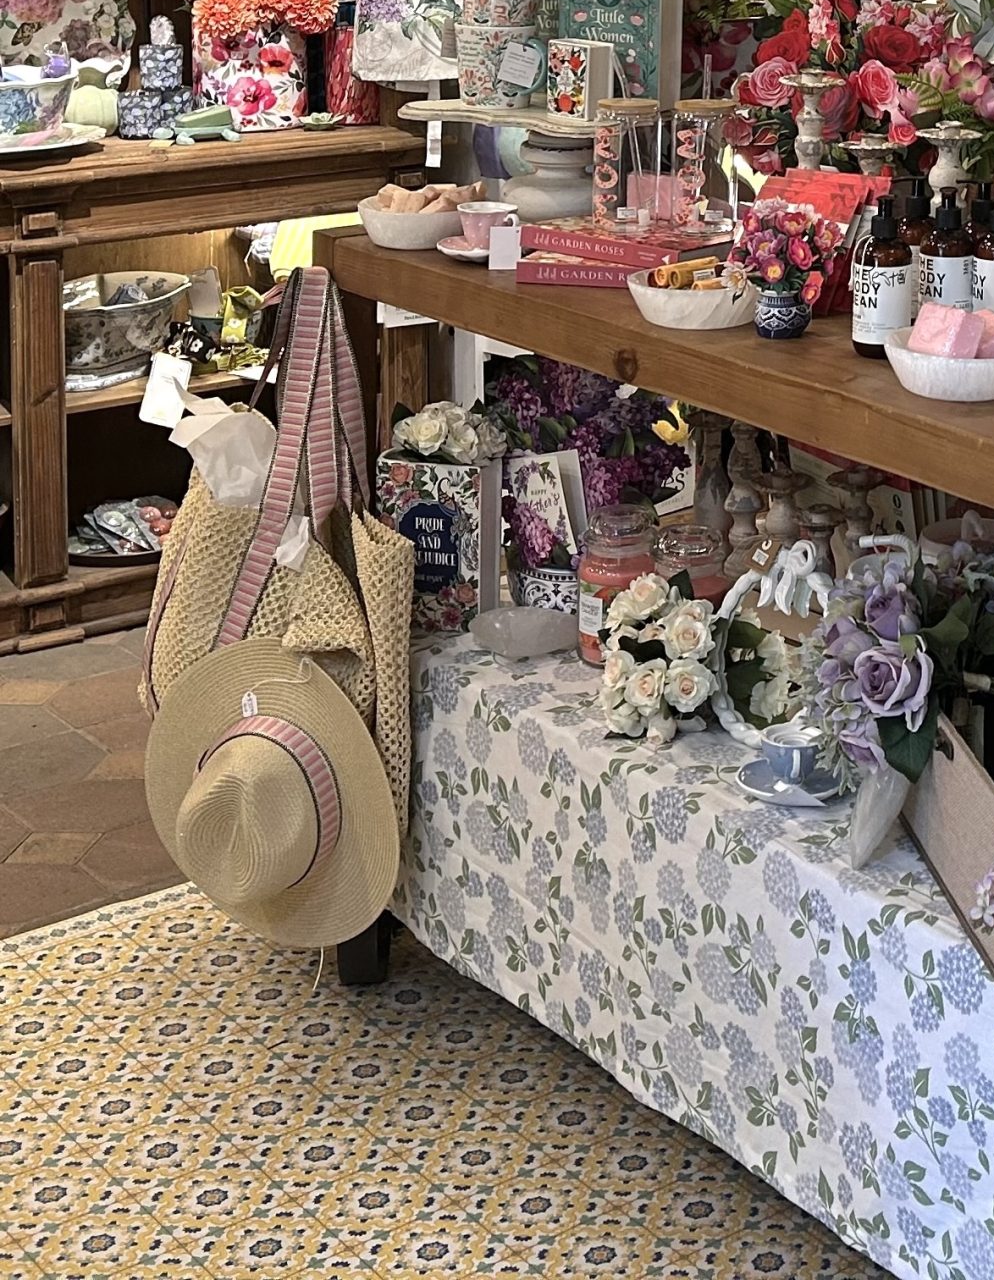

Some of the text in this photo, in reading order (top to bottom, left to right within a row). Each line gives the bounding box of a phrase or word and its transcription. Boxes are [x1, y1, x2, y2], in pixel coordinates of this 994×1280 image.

[590, 8, 625, 28] Little
[581, 25, 634, 43] Women
[552, 236, 592, 251] GARDEN
[595, 244, 625, 257] ROSES
[560, 269, 614, 281] GARDEN
[920, 270, 946, 285] ODY
[854, 280, 881, 295] ODY
[920, 283, 943, 298] EAN
[854, 294, 878, 308] EAN
[415, 516, 445, 533] PRIDE
[417, 532, 441, 550] AND
[414, 550, 457, 567] EJUDICE
